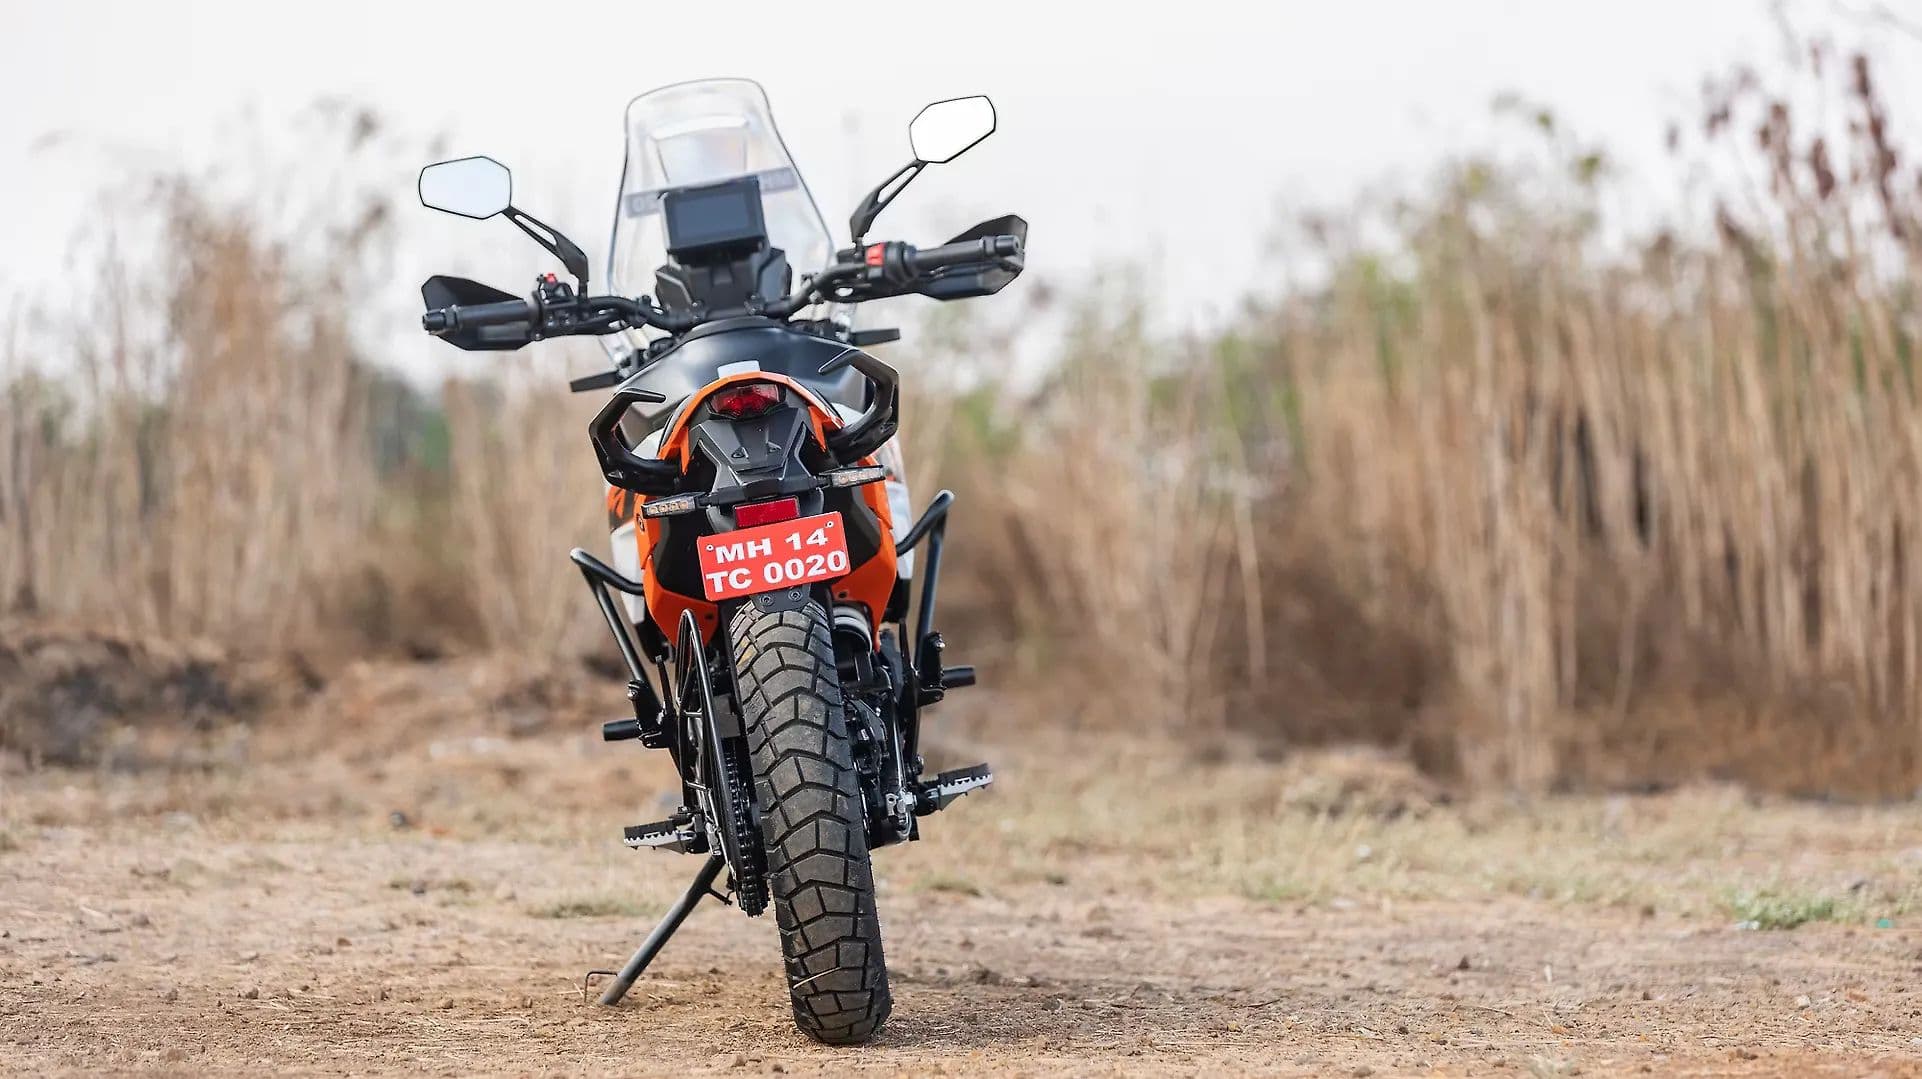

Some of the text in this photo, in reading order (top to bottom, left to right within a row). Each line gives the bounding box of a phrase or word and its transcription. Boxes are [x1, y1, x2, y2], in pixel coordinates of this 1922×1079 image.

[715, 527, 829, 564] MH 14
[705, 550, 847, 593] TC 0020
